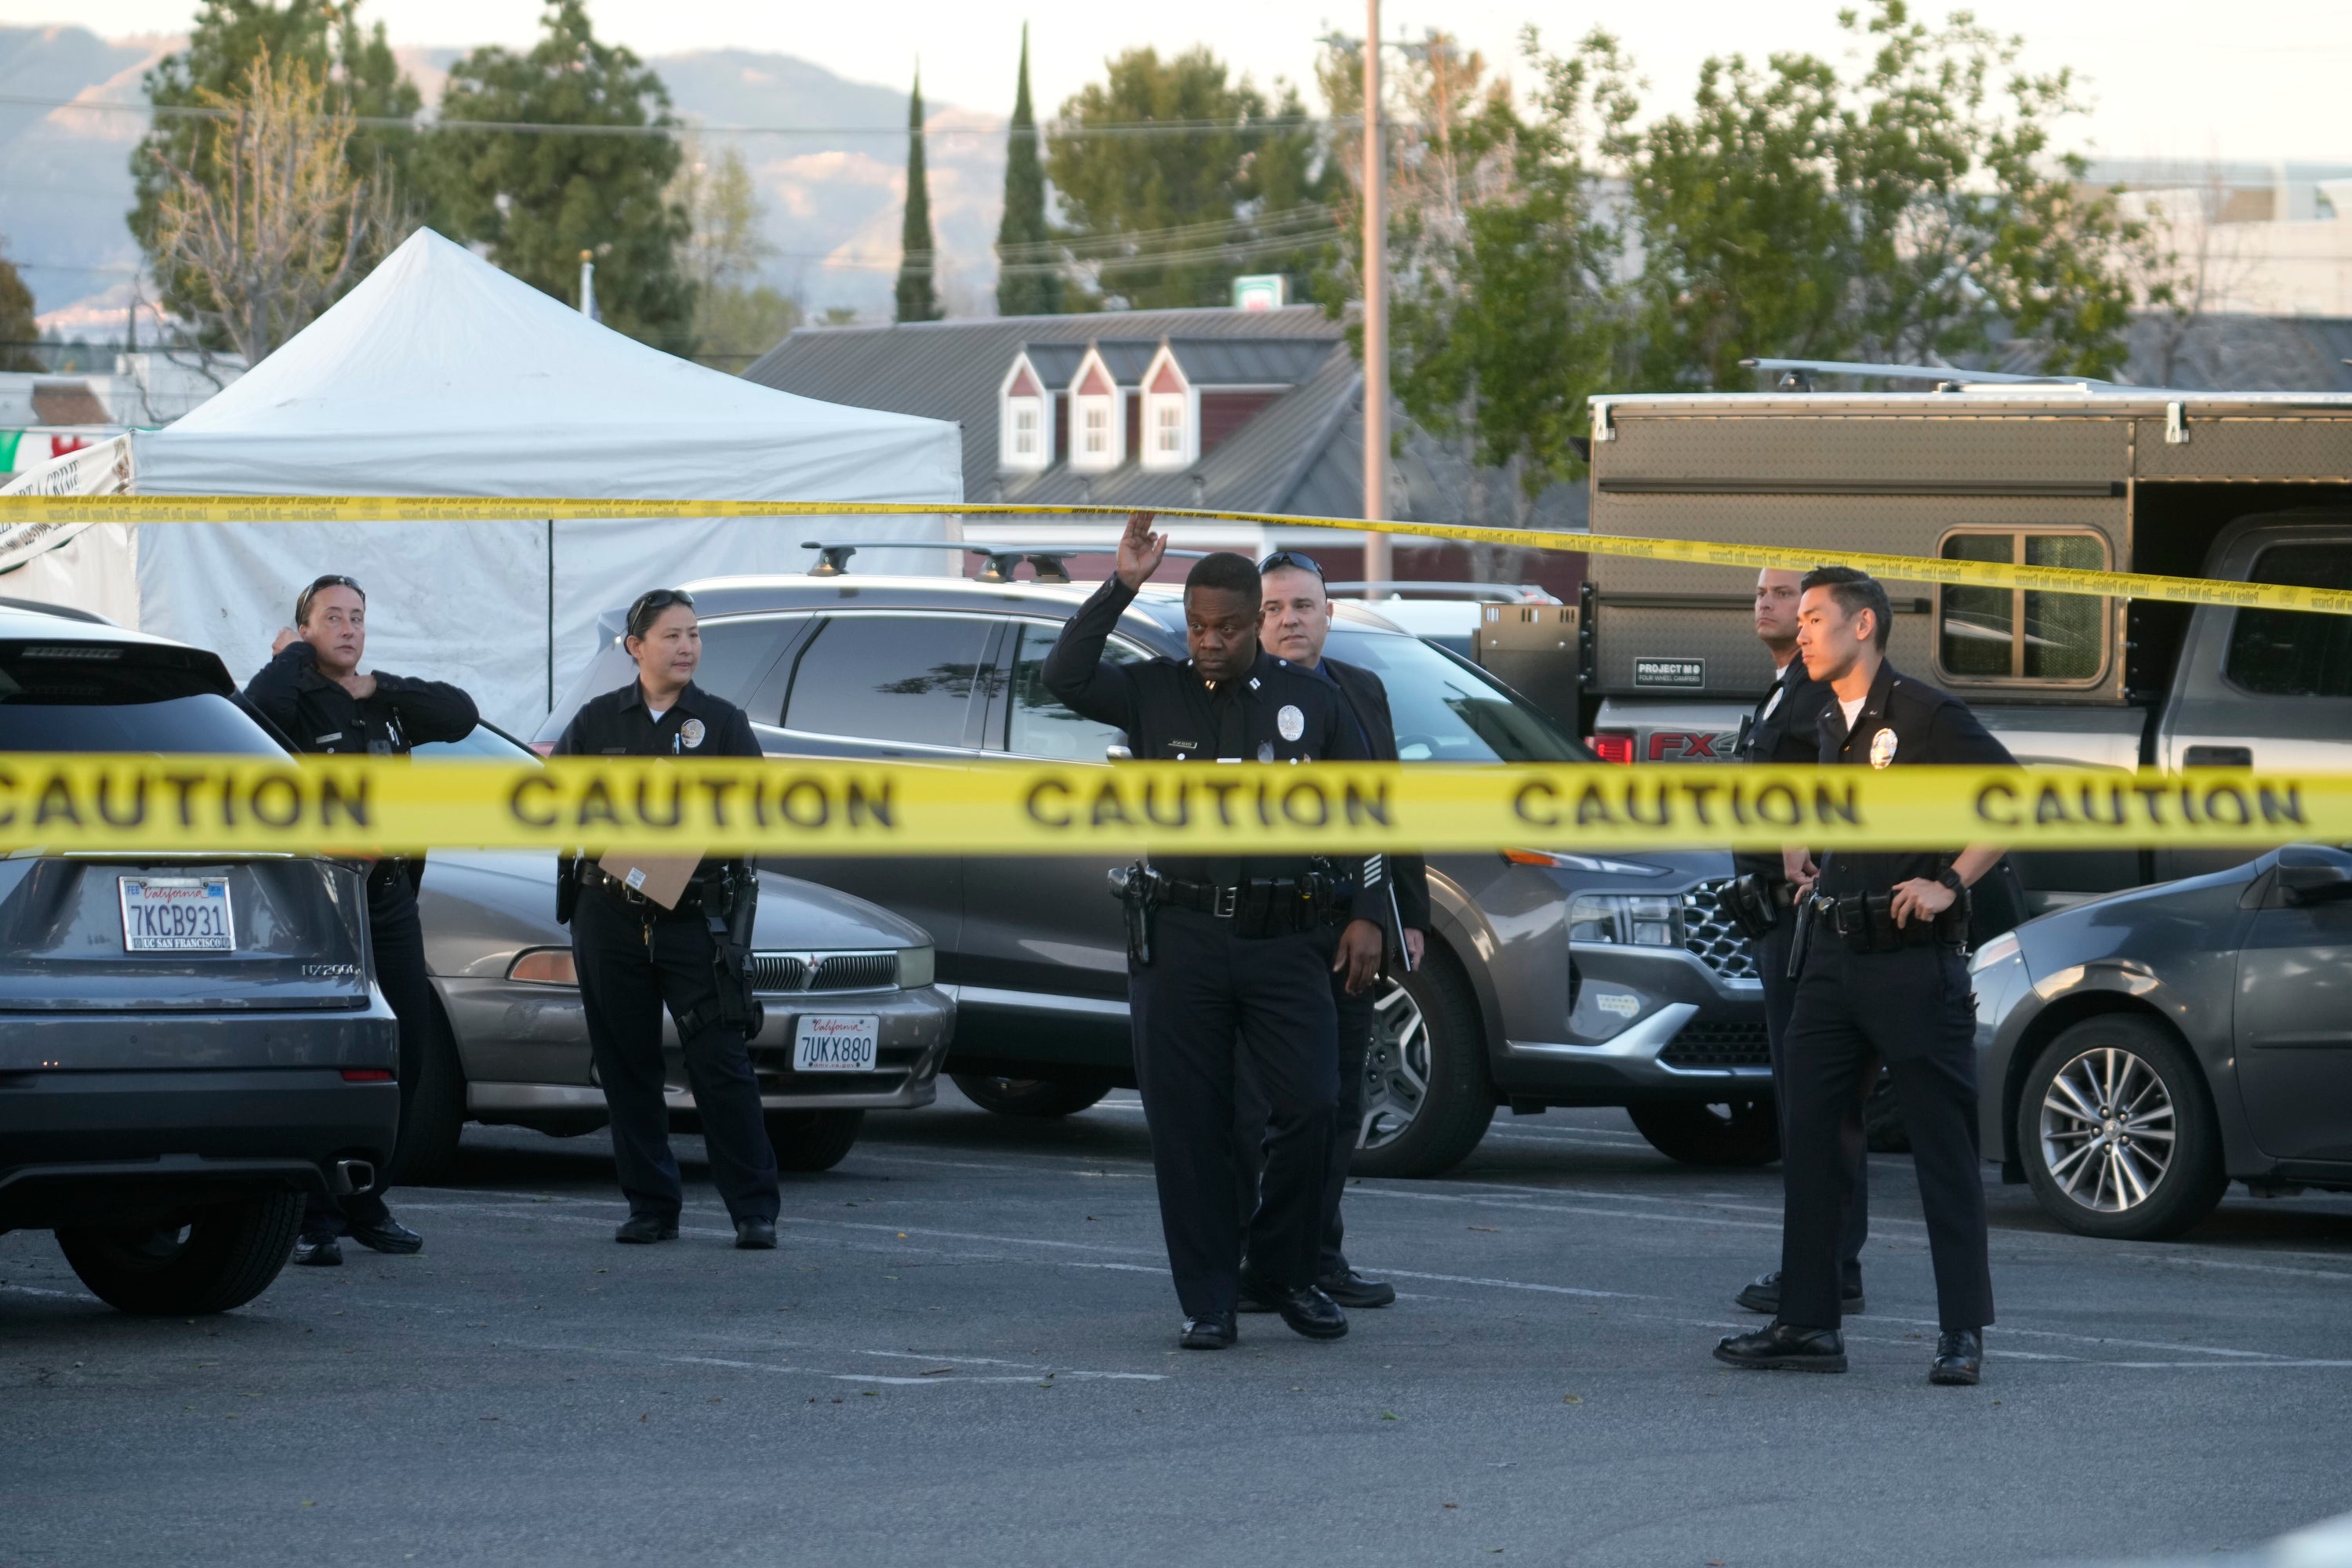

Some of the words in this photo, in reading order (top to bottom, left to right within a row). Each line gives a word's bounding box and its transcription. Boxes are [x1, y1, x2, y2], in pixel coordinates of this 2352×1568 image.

[1639, 663, 1682, 673] PROJECT
[1683, 664, 1693, 674] M
[510, 774, 898, 829] CAUTION
[1024, 775, 1394, 828] CAUTION
[1513, 777, 1863, 827] CAUTION
[1976, 779, 2307, 827] CAUTION
[127, 885, 140, 895] FEB
[143, 887, 209, 903] California
[131, 905, 225, 936] 7KCB931
[143, 938, 156, 948] UC
[157, 938, 173, 948] SAN
[175, 938, 221, 948] FRANCISCO
[813, 1019, 863, 1036] California
[802, 1036, 871, 1062] 7UKX880
